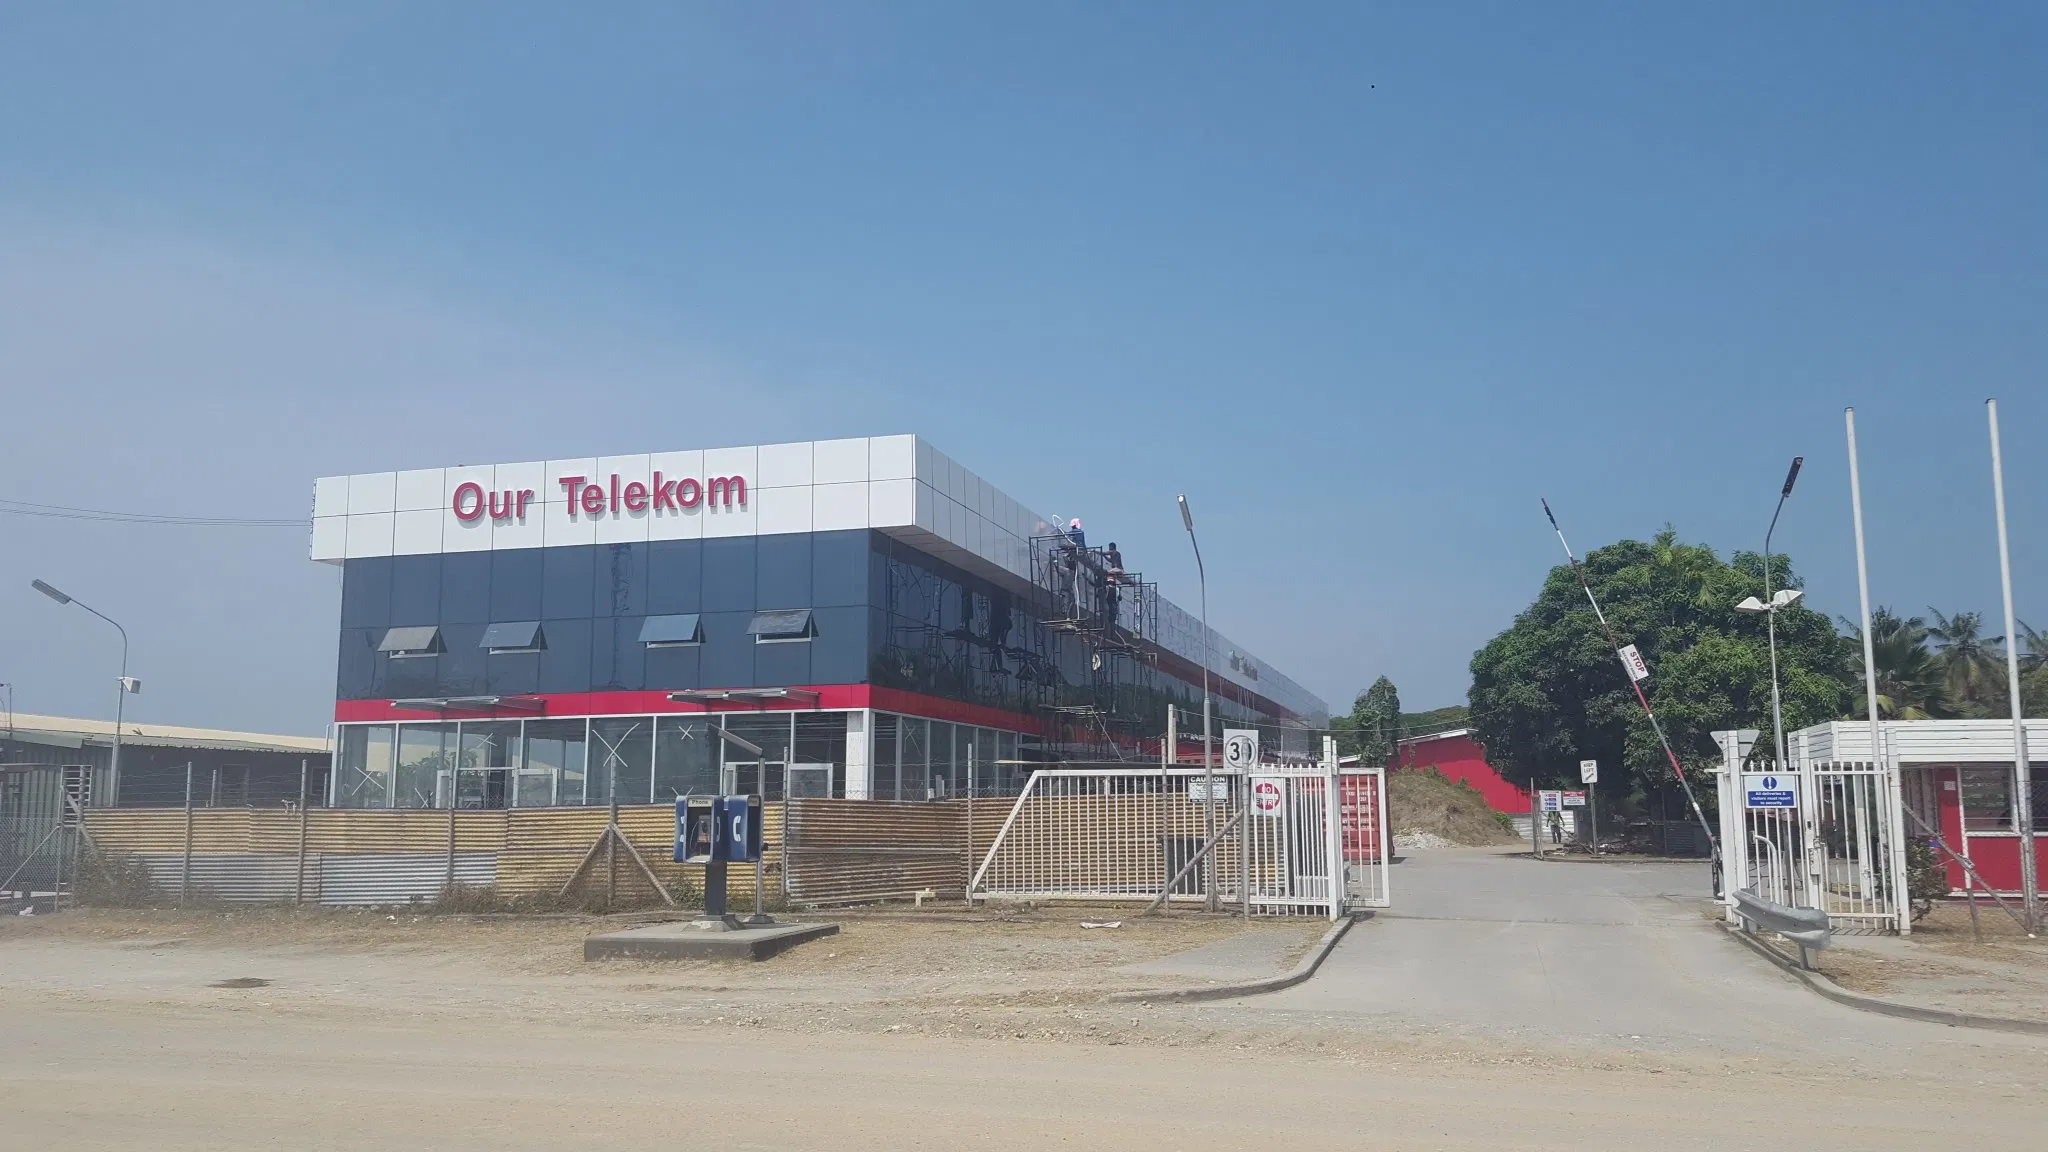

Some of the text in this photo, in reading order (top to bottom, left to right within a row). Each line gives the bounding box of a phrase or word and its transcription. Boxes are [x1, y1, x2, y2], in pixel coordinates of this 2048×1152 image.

[453, 471, 748, 521] Our Telekom
[1630, 651, 1645, 672] STOP
